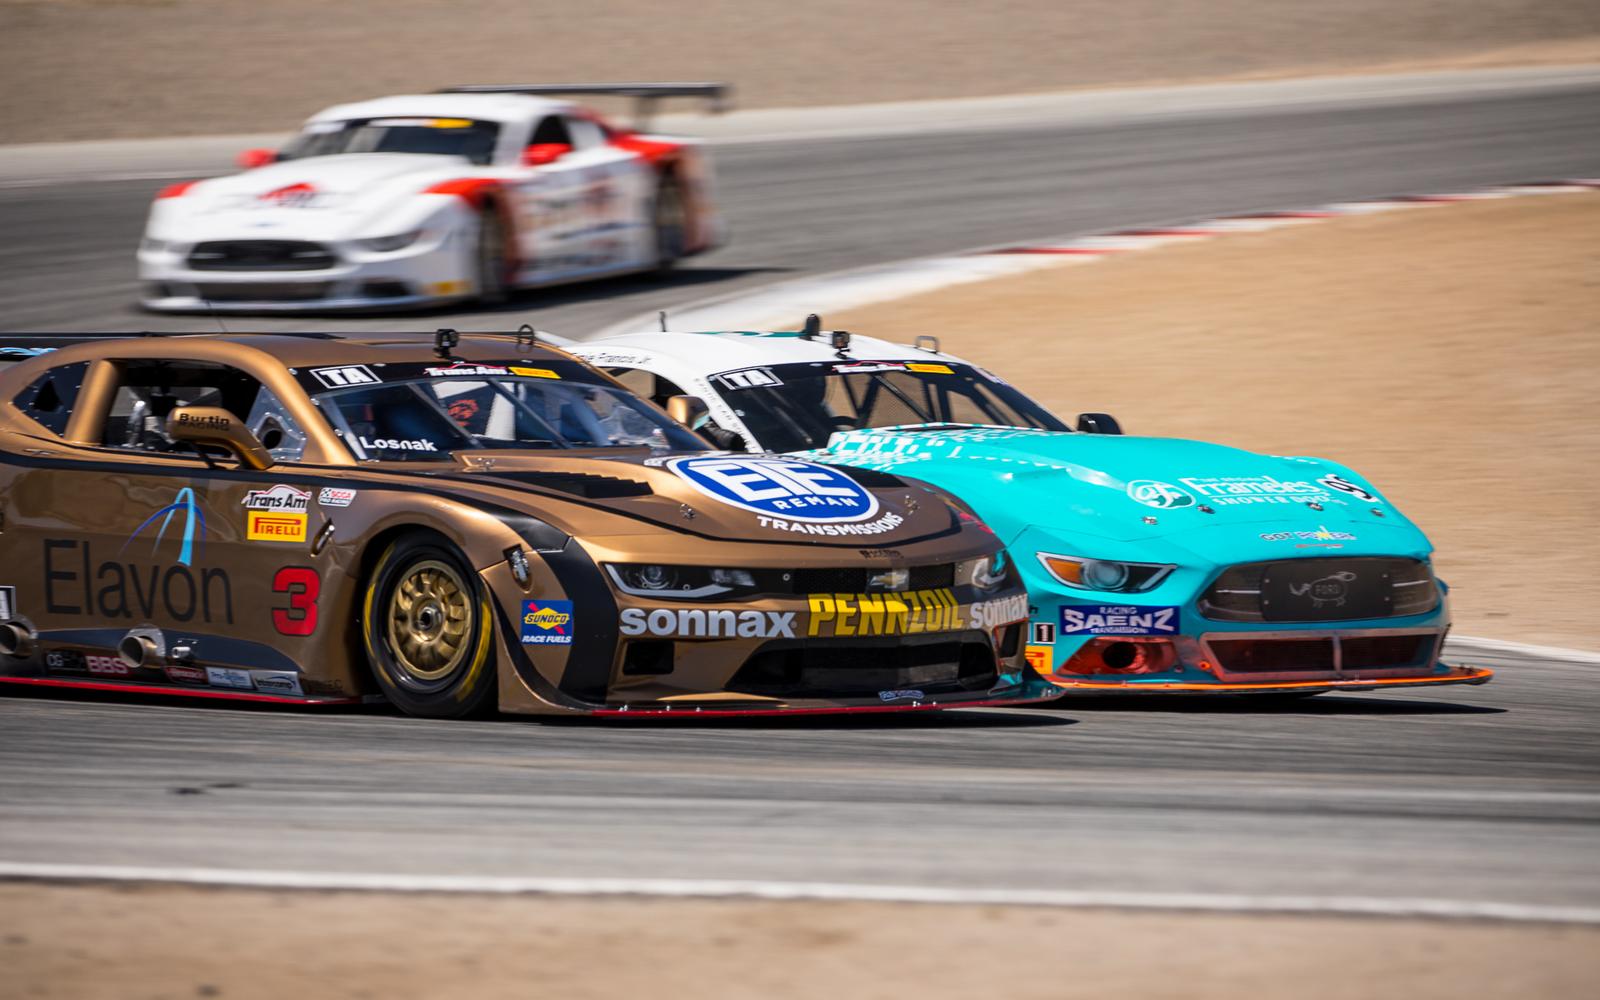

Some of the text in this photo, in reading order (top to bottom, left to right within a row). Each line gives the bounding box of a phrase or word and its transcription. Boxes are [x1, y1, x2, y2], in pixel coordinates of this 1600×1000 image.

[318, 367, 374, 385] TA
[722, 369, 776, 387] TA
[179, 412, 230, 425] Burtin
[359, 436, 438, 452] Losnak
[687, 459, 861, 502] ETE
[247, 492, 282, 507] Trans
[283, 493, 306, 509] Am
[772, 496, 860, 510] REMAN
[254, 516, 301, 536] PIRELLI
[757, 511, 904, 536] TRANSMISSIONS
[44, 538, 234, 624] Elavon
[271, 565, 321, 637] 3
[526, 614, 567, 623] SUNOCO
[808, 587, 964, 637] PENNZOIL
[970, 594, 1029, 630] sonnax
[1099, 606, 1138, 615] RACING
[619, 608, 797, 638] sonnax
[1064, 608, 1175, 633] SAENZ
[522, 635, 572, 643] RACE FUELS
[1039, 625, 1049, 642] 1
[85, 655, 129, 674] BBS
